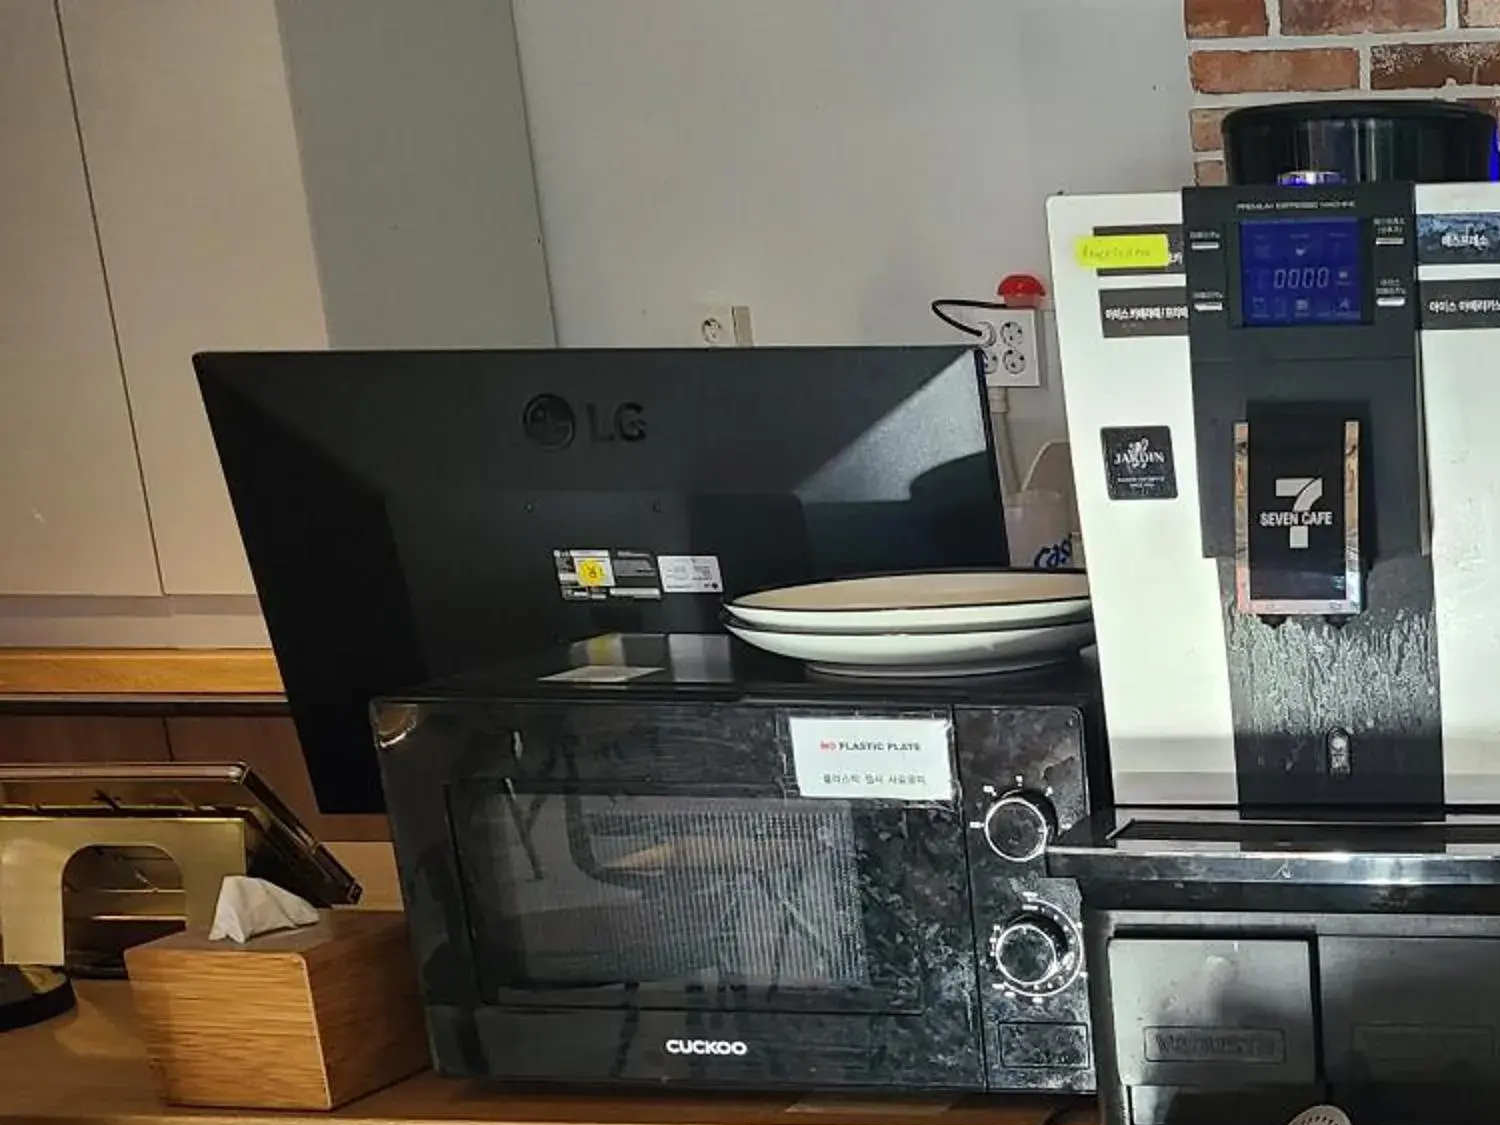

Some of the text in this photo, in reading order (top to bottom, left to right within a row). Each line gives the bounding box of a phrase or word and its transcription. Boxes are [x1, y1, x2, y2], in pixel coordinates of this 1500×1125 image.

[1273, 266, 1330, 290] 0000
[587, 401, 648, 442] LG
[1259, 511, 1333, 526] SEVEN CAFE
[665, 1039, 749, 1056] CUCKOO
